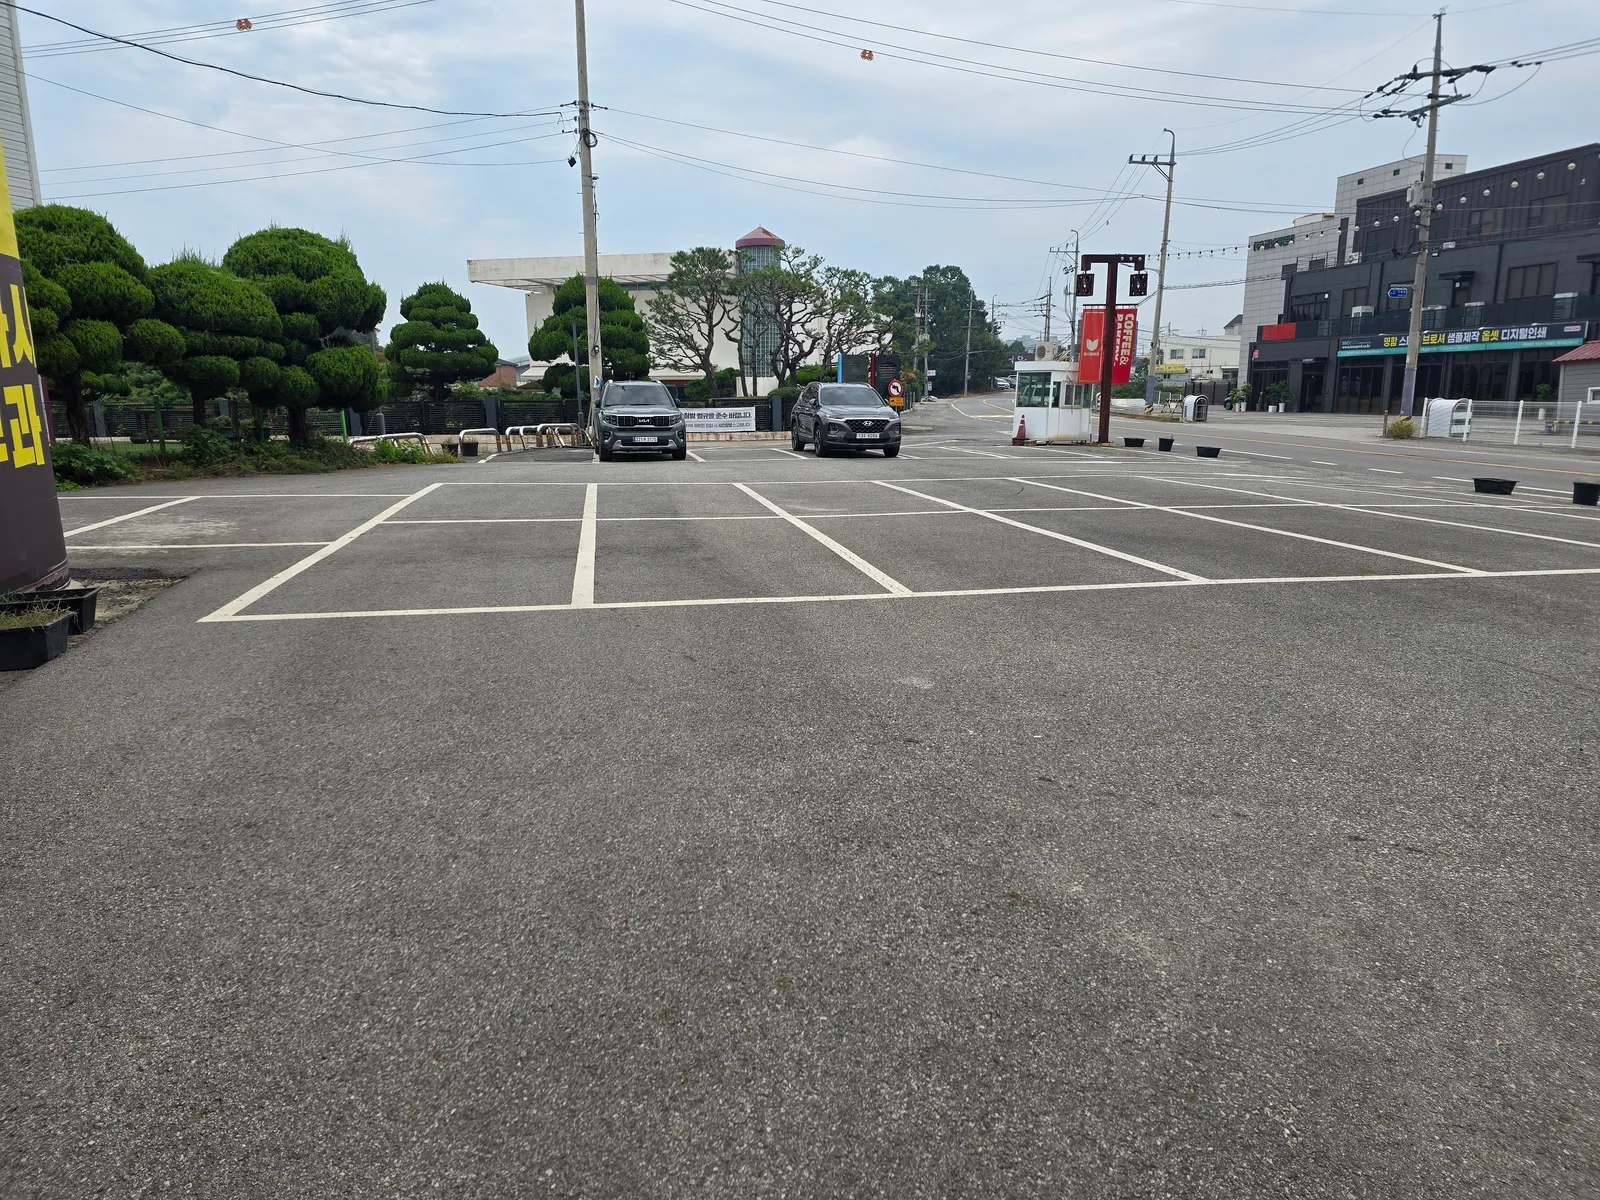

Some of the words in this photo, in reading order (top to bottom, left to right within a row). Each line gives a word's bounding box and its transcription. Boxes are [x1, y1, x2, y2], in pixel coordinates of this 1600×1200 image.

[1383, 336, 1398, 347] 명함
[1422, 333, 1446, 345] 브로셔
[1447, 330, 1480, 344] 샘플제작
[1481, 329, 1499, 342] 옵셋
[1501, 326, 1548, 340] 디지털인쇄
